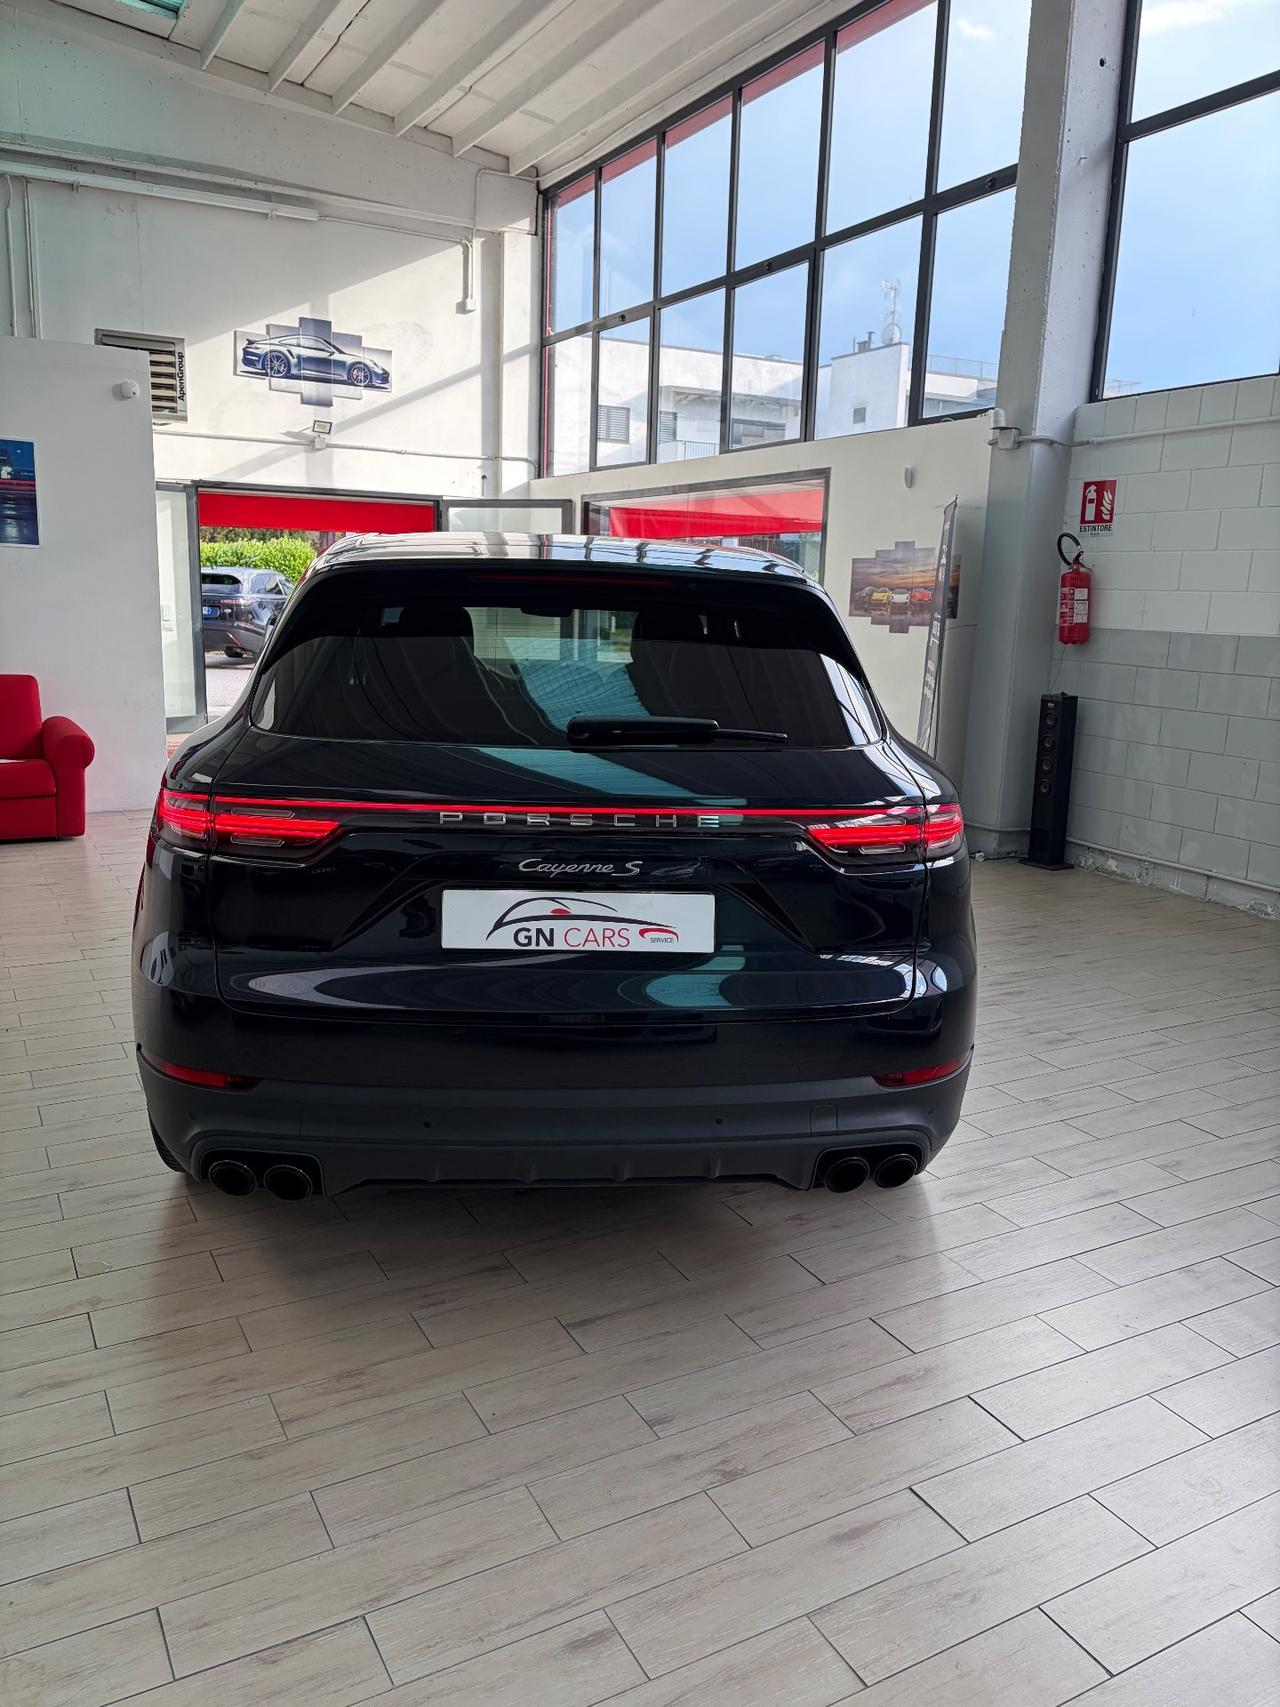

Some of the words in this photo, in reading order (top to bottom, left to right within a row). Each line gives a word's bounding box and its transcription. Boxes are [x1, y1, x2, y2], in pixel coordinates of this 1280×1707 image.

[177, 352, 186, 401] ApenGroup
[1079, 524, 1112, 532] ESTINTORE
[439, 811, 720, 828] PORSCHE
[518, 858, 615, 878] Cayenne
[611, 861, 643, 877] S
[513, 927, 555, 947] GN
[564, 927, 630, 947] CARS
